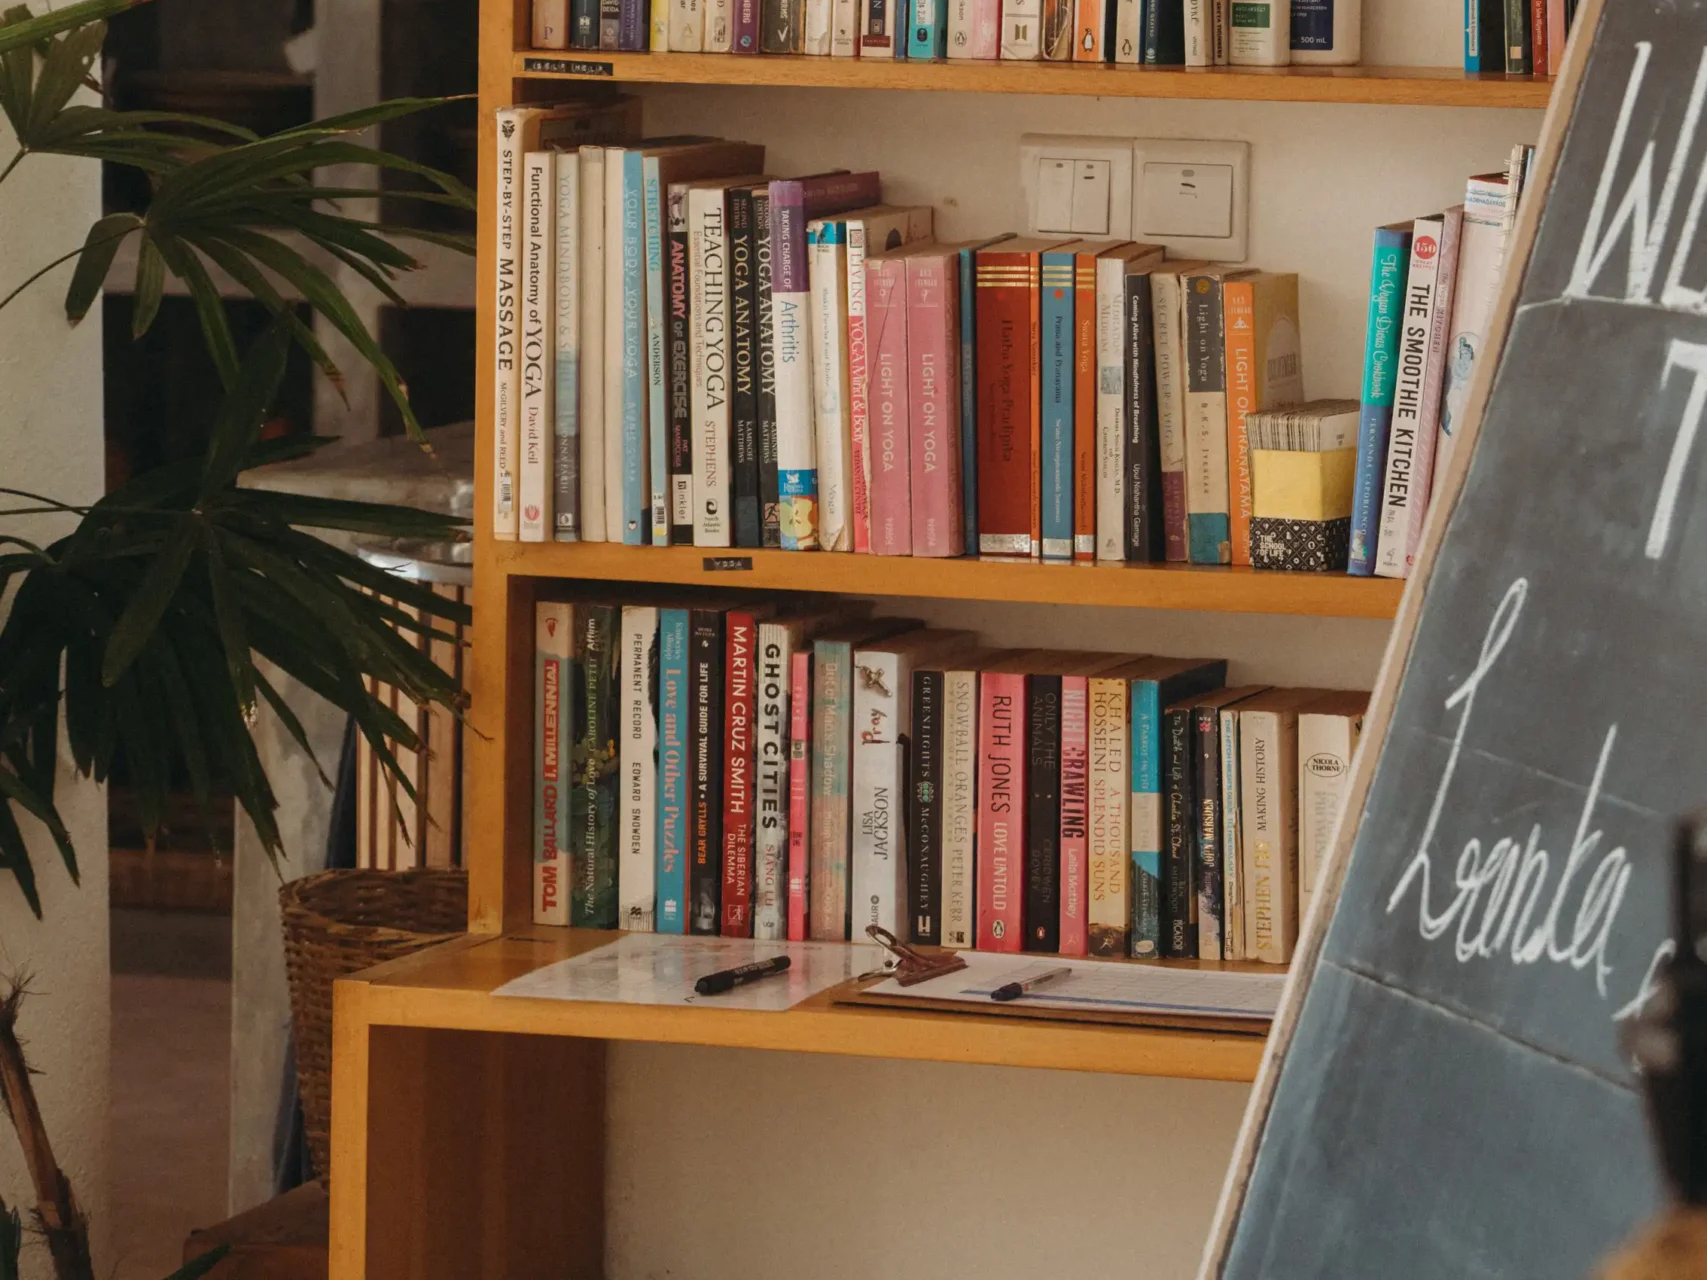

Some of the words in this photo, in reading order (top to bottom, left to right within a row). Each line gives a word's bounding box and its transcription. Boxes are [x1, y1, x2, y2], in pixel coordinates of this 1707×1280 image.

[602, 6, 620, 14] DEIDA
[1300, 36, 1315, 44] 500
[1316, 36, 1327, 44] mL
[500, 149, 512, 250] STEP-BY-STEP
[530, 166, 543, 237] Functional
[646, 178, 659, 272] STRETCHING
[528, 241, 542, 306] Anatomy
[670, 239, 685, 318] ANATOMY
[703, 206, 724, 333] TEACHING
[734, 234, 749, 291] YOGA
[757, 236, 772, 291] YOGA
[497, 257, 515, 371] MASSAGE
[528, 309, 540, 325] of
[673, 321, 684, 338] OF
[1410, 283, 1431, 318] THE
[735, 296, 752, 395] ANATOMY
[758, 296, 776, 396] ANATOMY
[780, 300, 798, 363] Arthritis
[524, 325, 543, 399] YOGA
[671, 340, 687, 419] EXERCISE
[705, 338, 726, 411] YOGA
[881, 352, 893, 398] LIGHT
[923, 352, 935, 398] LIGHT
[1399, 326, 1426, 420] SMOOTHIE
[880, 401, 893, 426] ON
[923, 401, 936, 426] ON
[704, 419, 716, 488] STEPHENS
[880, 428, 893, 472] YOGA
[922, 428, 935, 472] YOGA
[1388, 428, 1415, 509] KITCHEN
[1260, 542, 1286, 551] SCHOOL
[1260, 549, 1269, 558] OF
[1269, 549, 1283, 558] LIFE
[633, 633, 642, 693] PERMANENT
[666, 667, 680, 711] Love
[733, 625, 747, 697] MARTIN
[764, 642, 781, 737] GHOST
[632, 698, 641, 740] RECORD
[665, 712, 680, 746] and
[731, 700, 746, 752] CRUZ
[862, 707, 890, 746] Pray
[921, 676, 932, 779] GREENLIGHTS
[955, 680, 969, 767] SNOWBALL
[992, 695, 1012, 748] RUTH
[1094, 691, 1108, 773] HOSSEINI
[1108, 692, 1123, 774] KHALED
[665, 748, 680, 803] Other
[729, 756, 745, 815] SMITH
[762, 743, 778, 829] CITIES
[987, 754, 1011, 814] JONES
[1254, 737, 1265, 785] HISTORY
[953, 772, 967, 845] ORANGES
[1093, 778, 1107, 856] SPLENDID
[1109, 786, 1121, 798] A
[1256, 786, 1267, 832] MAKING
[542, 785, 558, 861] BALLARD
[663, 804, 679, 874] Puzzles
[861, 810, 873, 836] LISA
[873, 786, 889, 861] JACKSON
[993, 821, 1007, 854] LOVE
[1108, 803, 1120, 895] THOUSAND
[542, 865, 557, 910] TOM
[919, 807, 930, 910] McCONAUGHEY
[991, 857, 1007, 911] UNTOLD
[1092, 859, 1106, 902] SUNS
